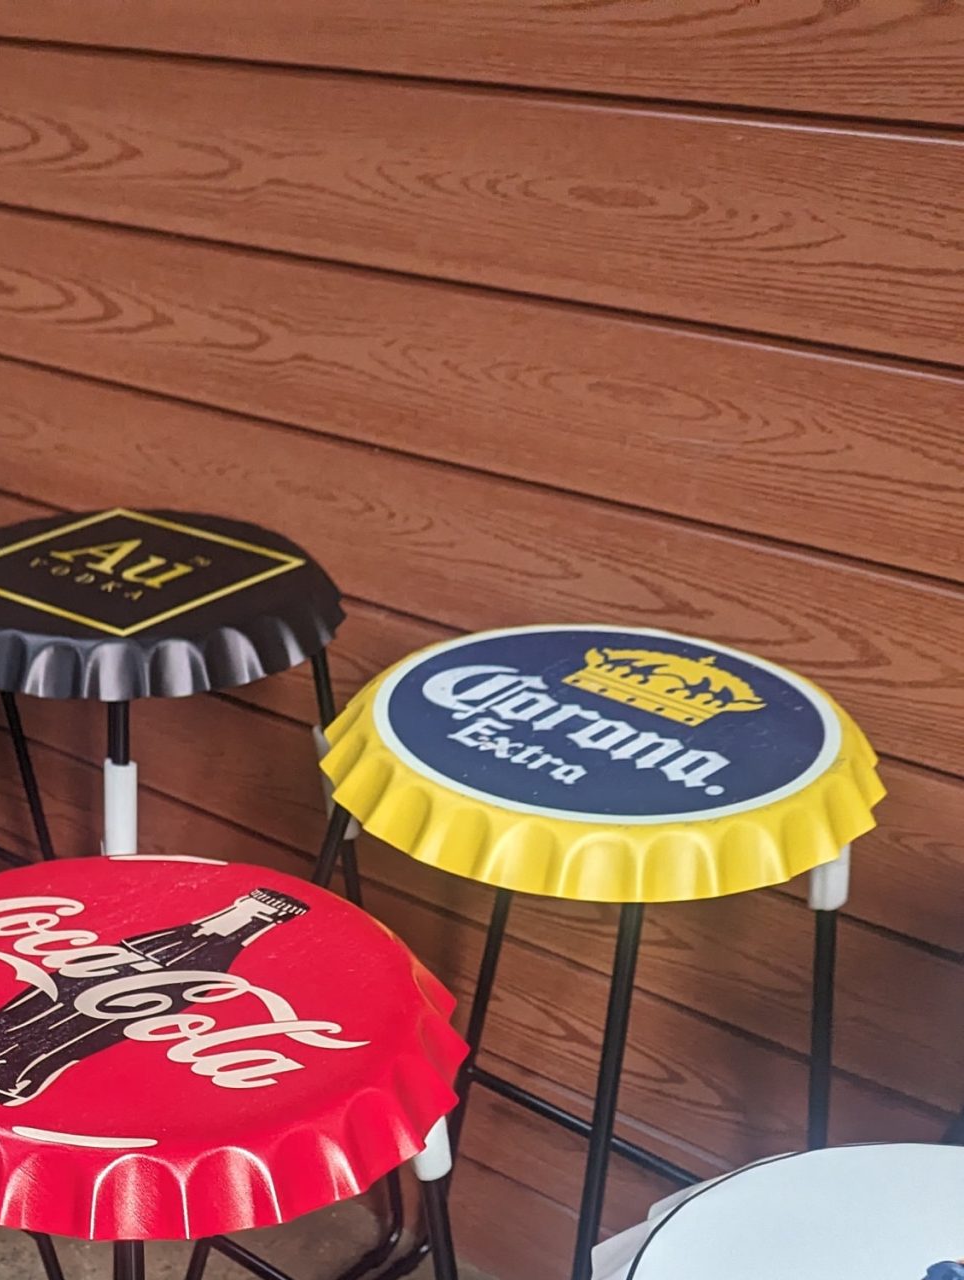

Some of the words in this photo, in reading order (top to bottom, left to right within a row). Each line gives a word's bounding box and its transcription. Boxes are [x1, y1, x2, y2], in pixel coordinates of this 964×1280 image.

[29, 557, 143, 601] VODKA
[49, 538, 193, 589] Au
[447, 717, 588, 784] Extra
